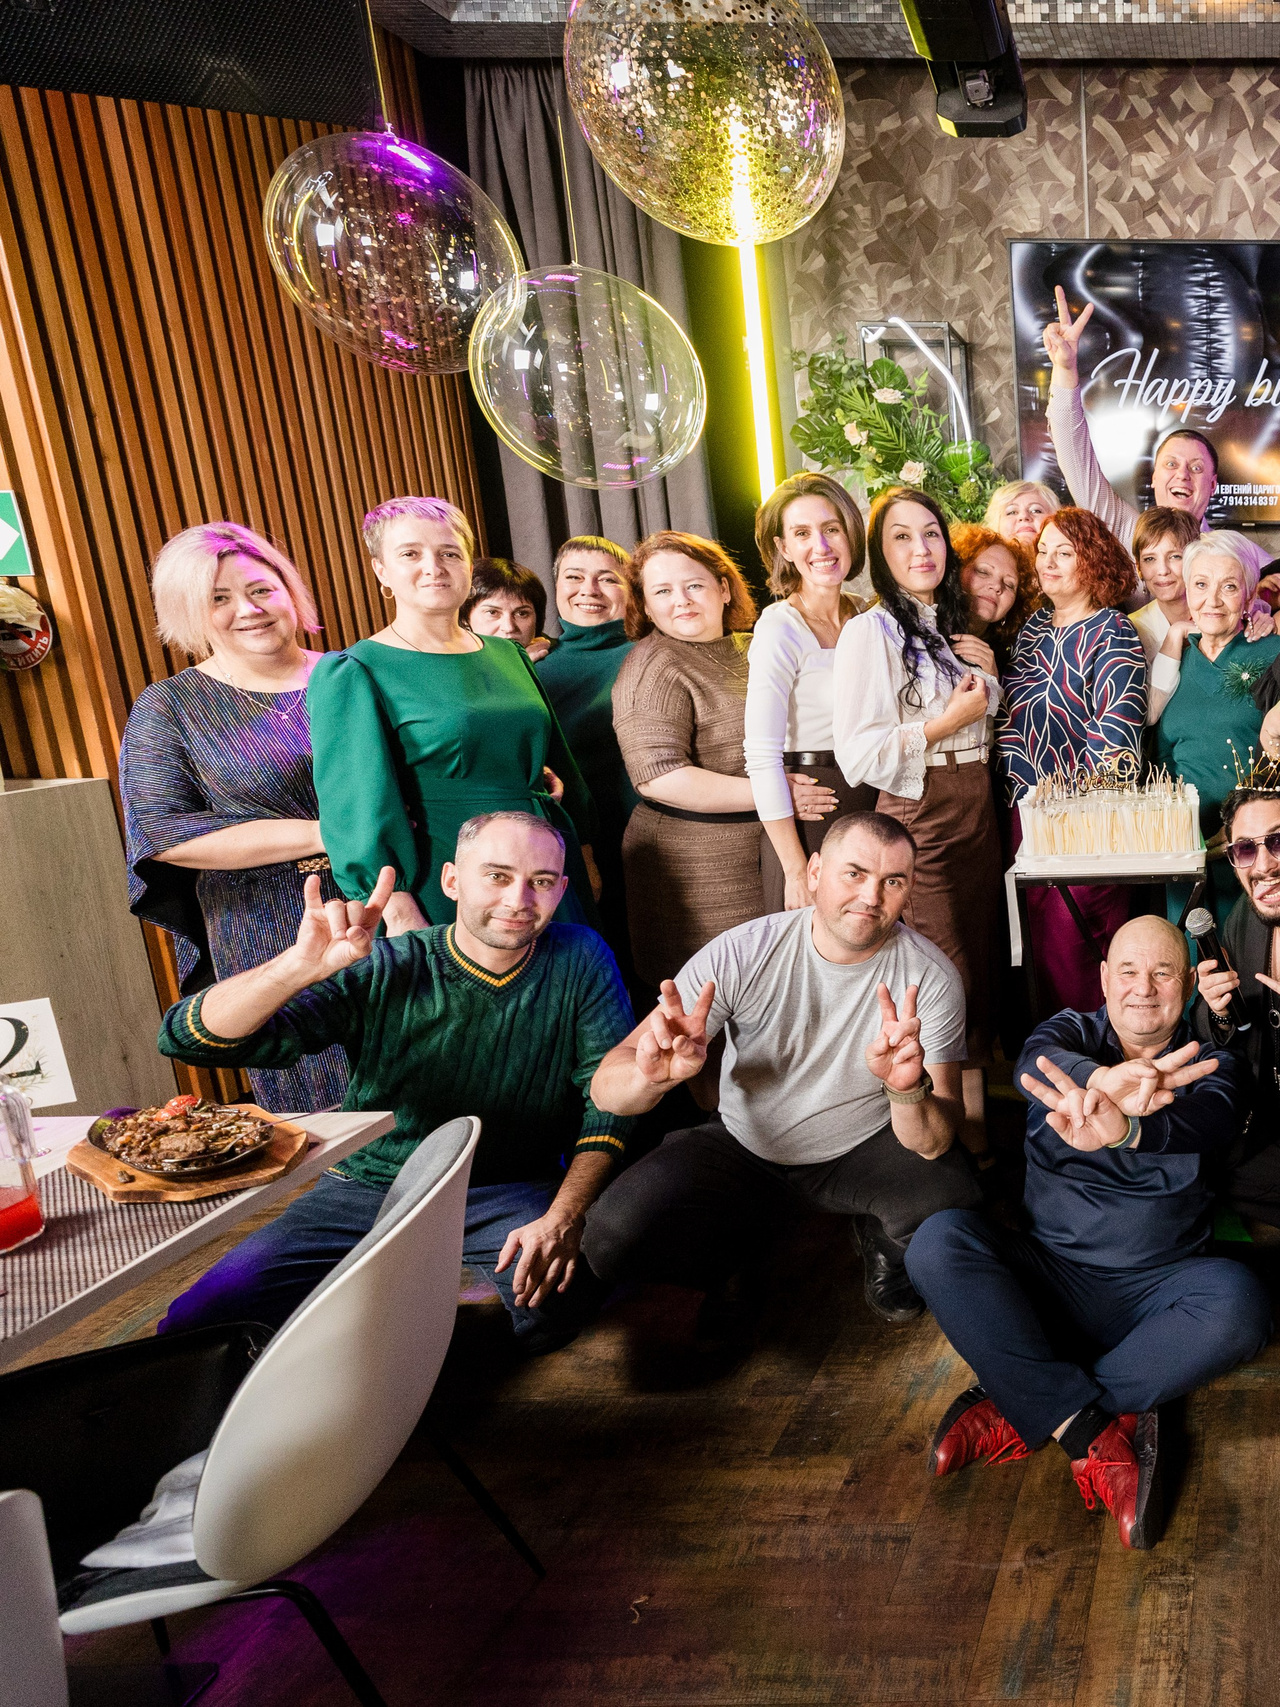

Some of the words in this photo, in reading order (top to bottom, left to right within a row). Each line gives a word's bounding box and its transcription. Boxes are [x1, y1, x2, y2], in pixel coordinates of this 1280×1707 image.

[1090, 347, 1236, 424] Happy
[1218, 496, 1228, 506] +7
[1229, 496, 1243, 506] 914
[1243, 496, 1258, 506] 314
[1258, 496, 1268, 506] 83
[1269, 496, 1279, 506] 97
[1220, 483, 1252, 495] ЕВГЕНИЙ
[1096, 744, 1135, 778] 50
[0, 1017, 43, 1079] 2
